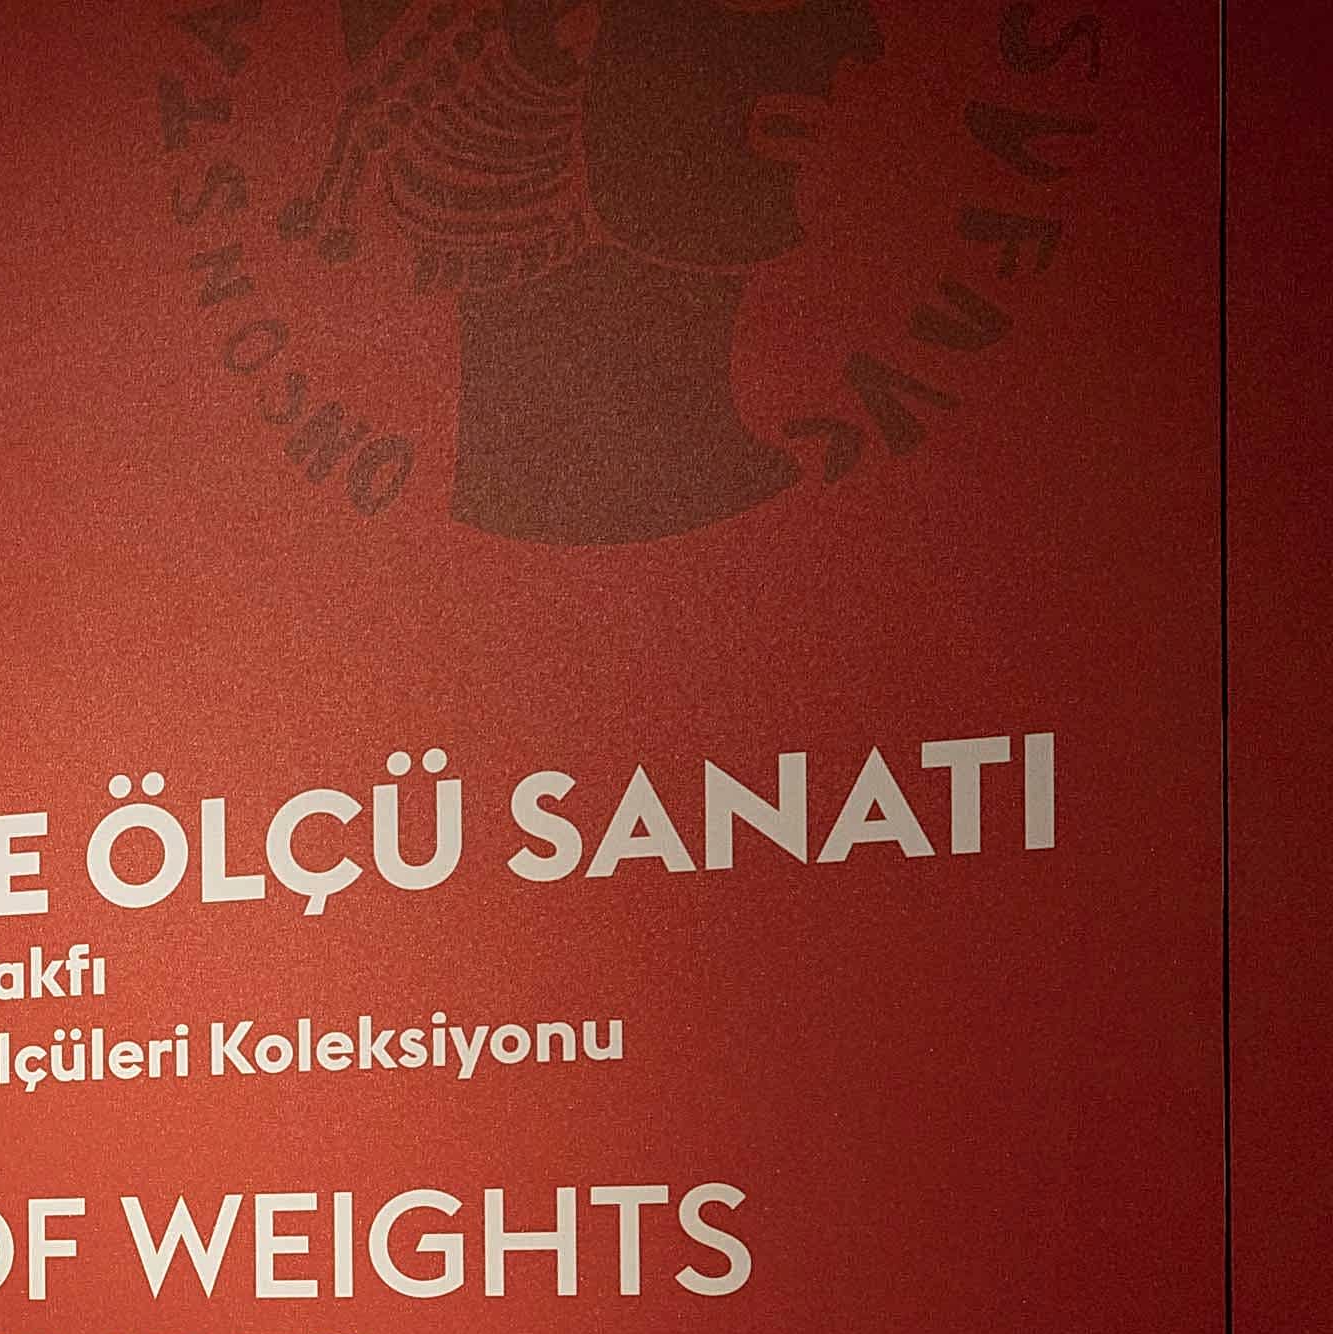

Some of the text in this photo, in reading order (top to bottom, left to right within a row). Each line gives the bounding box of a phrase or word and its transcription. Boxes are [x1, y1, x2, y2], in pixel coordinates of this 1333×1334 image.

[86, 747, 463, 917] ÖLÇÜ
[505, 732, 1055, 882] SANATI
[210, 1011, 623, 1080] Koleksiyonu
[119, 1182, 752, 1300] WEIGHTS
